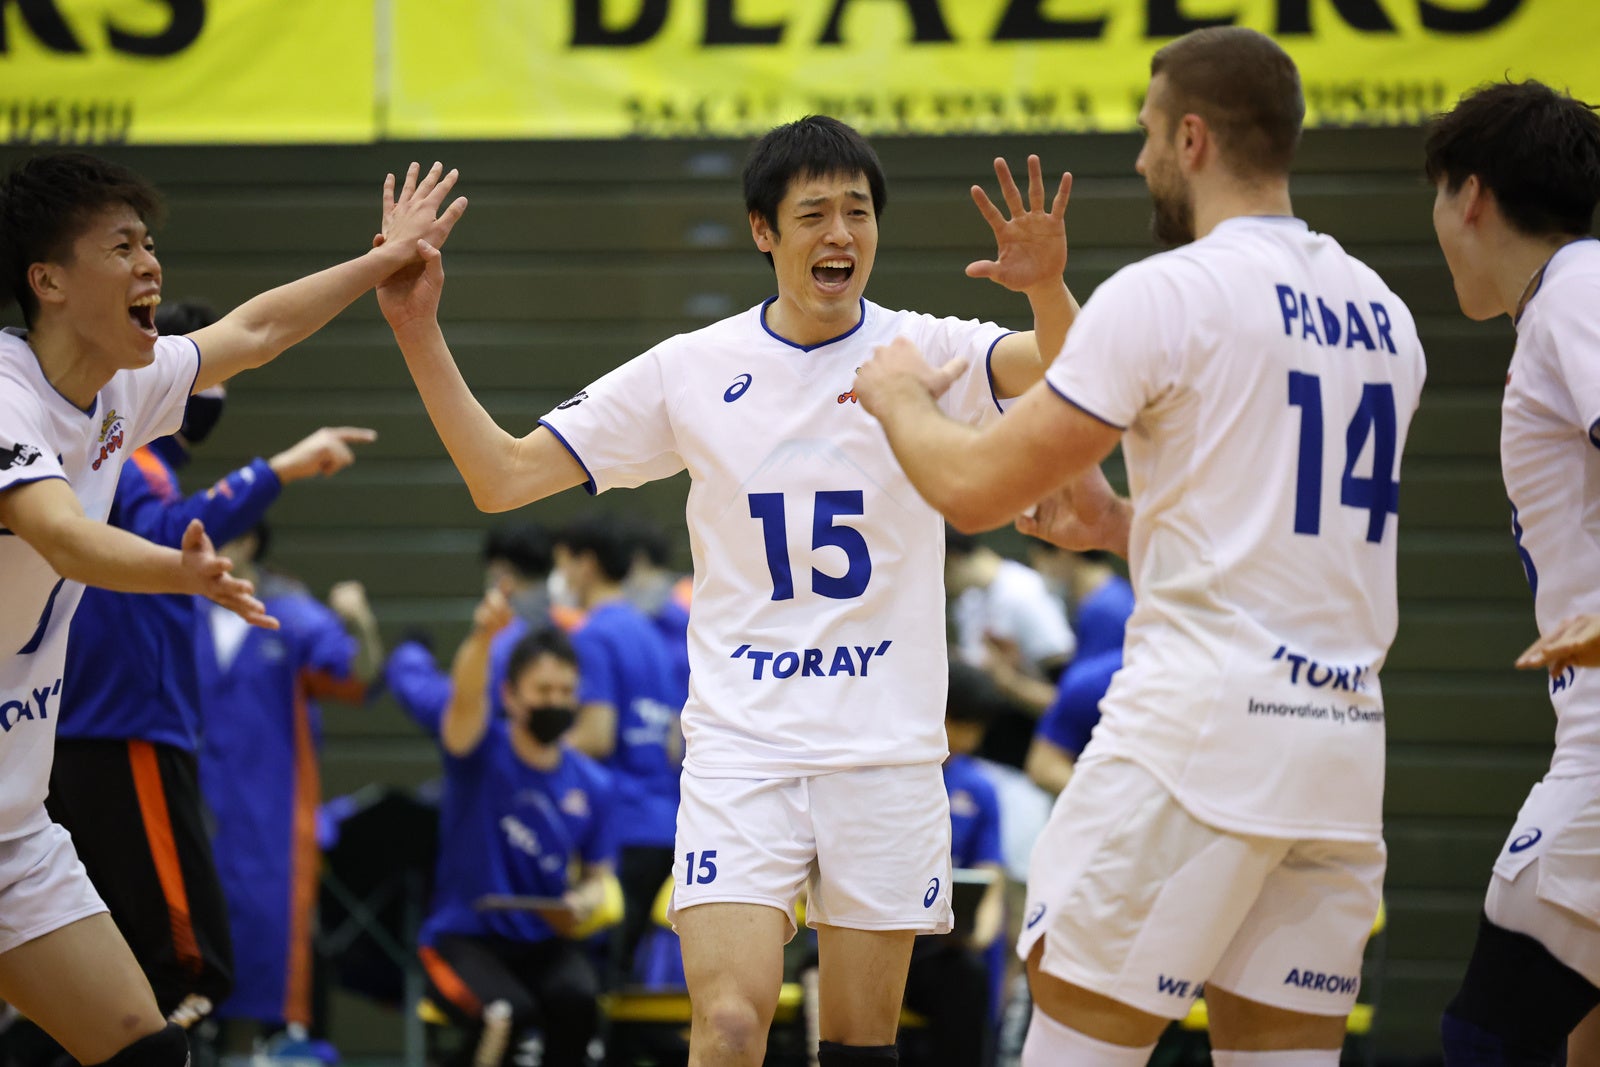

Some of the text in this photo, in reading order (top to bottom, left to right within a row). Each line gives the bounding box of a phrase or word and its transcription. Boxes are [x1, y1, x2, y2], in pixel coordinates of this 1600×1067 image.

[1275, 284, 1397, 354] PADAR
[1288, 370, 1399, 543] 14
[748, 490, 872, 600] 15
[1248, 698, 1329, 718] Innovation
[1332, 704, 1345, 724] by
[686, 850, 717, 885] 15
[1157, 974, 1191, 998] WE
